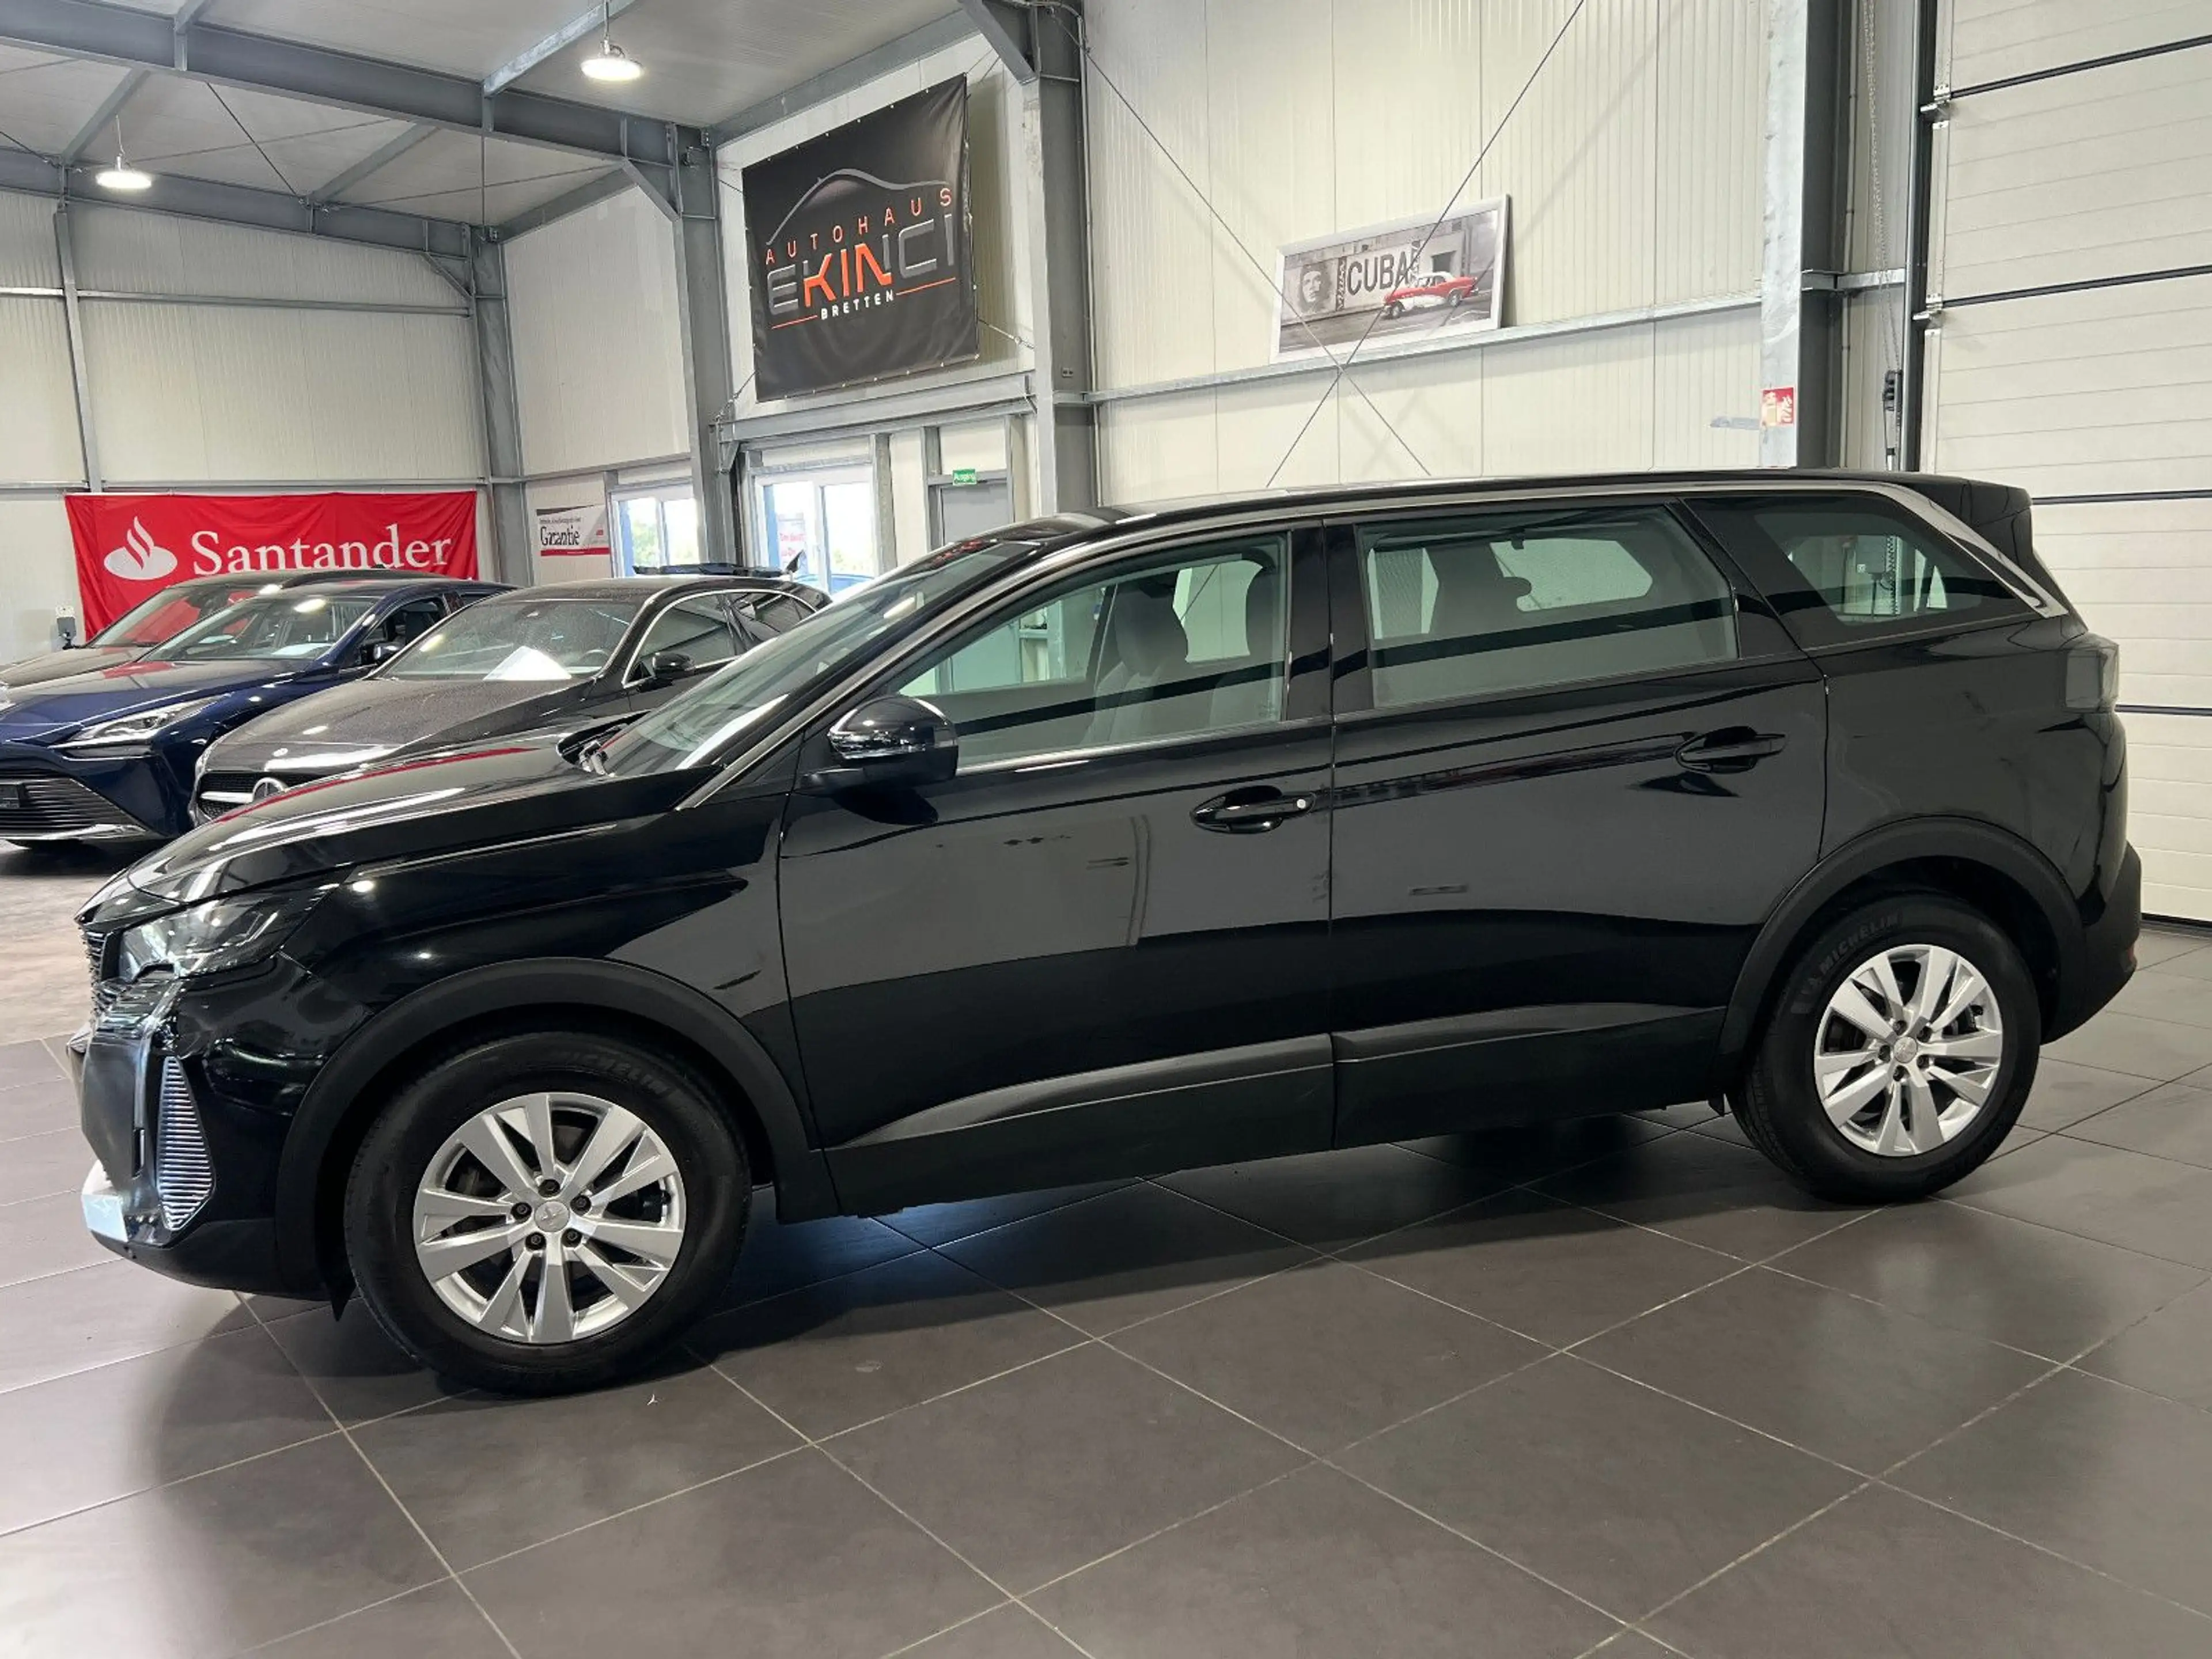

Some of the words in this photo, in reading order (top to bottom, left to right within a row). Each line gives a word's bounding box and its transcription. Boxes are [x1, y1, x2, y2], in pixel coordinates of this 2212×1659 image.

[766, 187, 952, 264] AUTOHAUS
[767, 214, 953, 315] EKINCI
[1347, 251, 1409, 296] CUBA
[821, 289, 894, 320] BRETTEN
[191, 523, 452, 576] Santander
